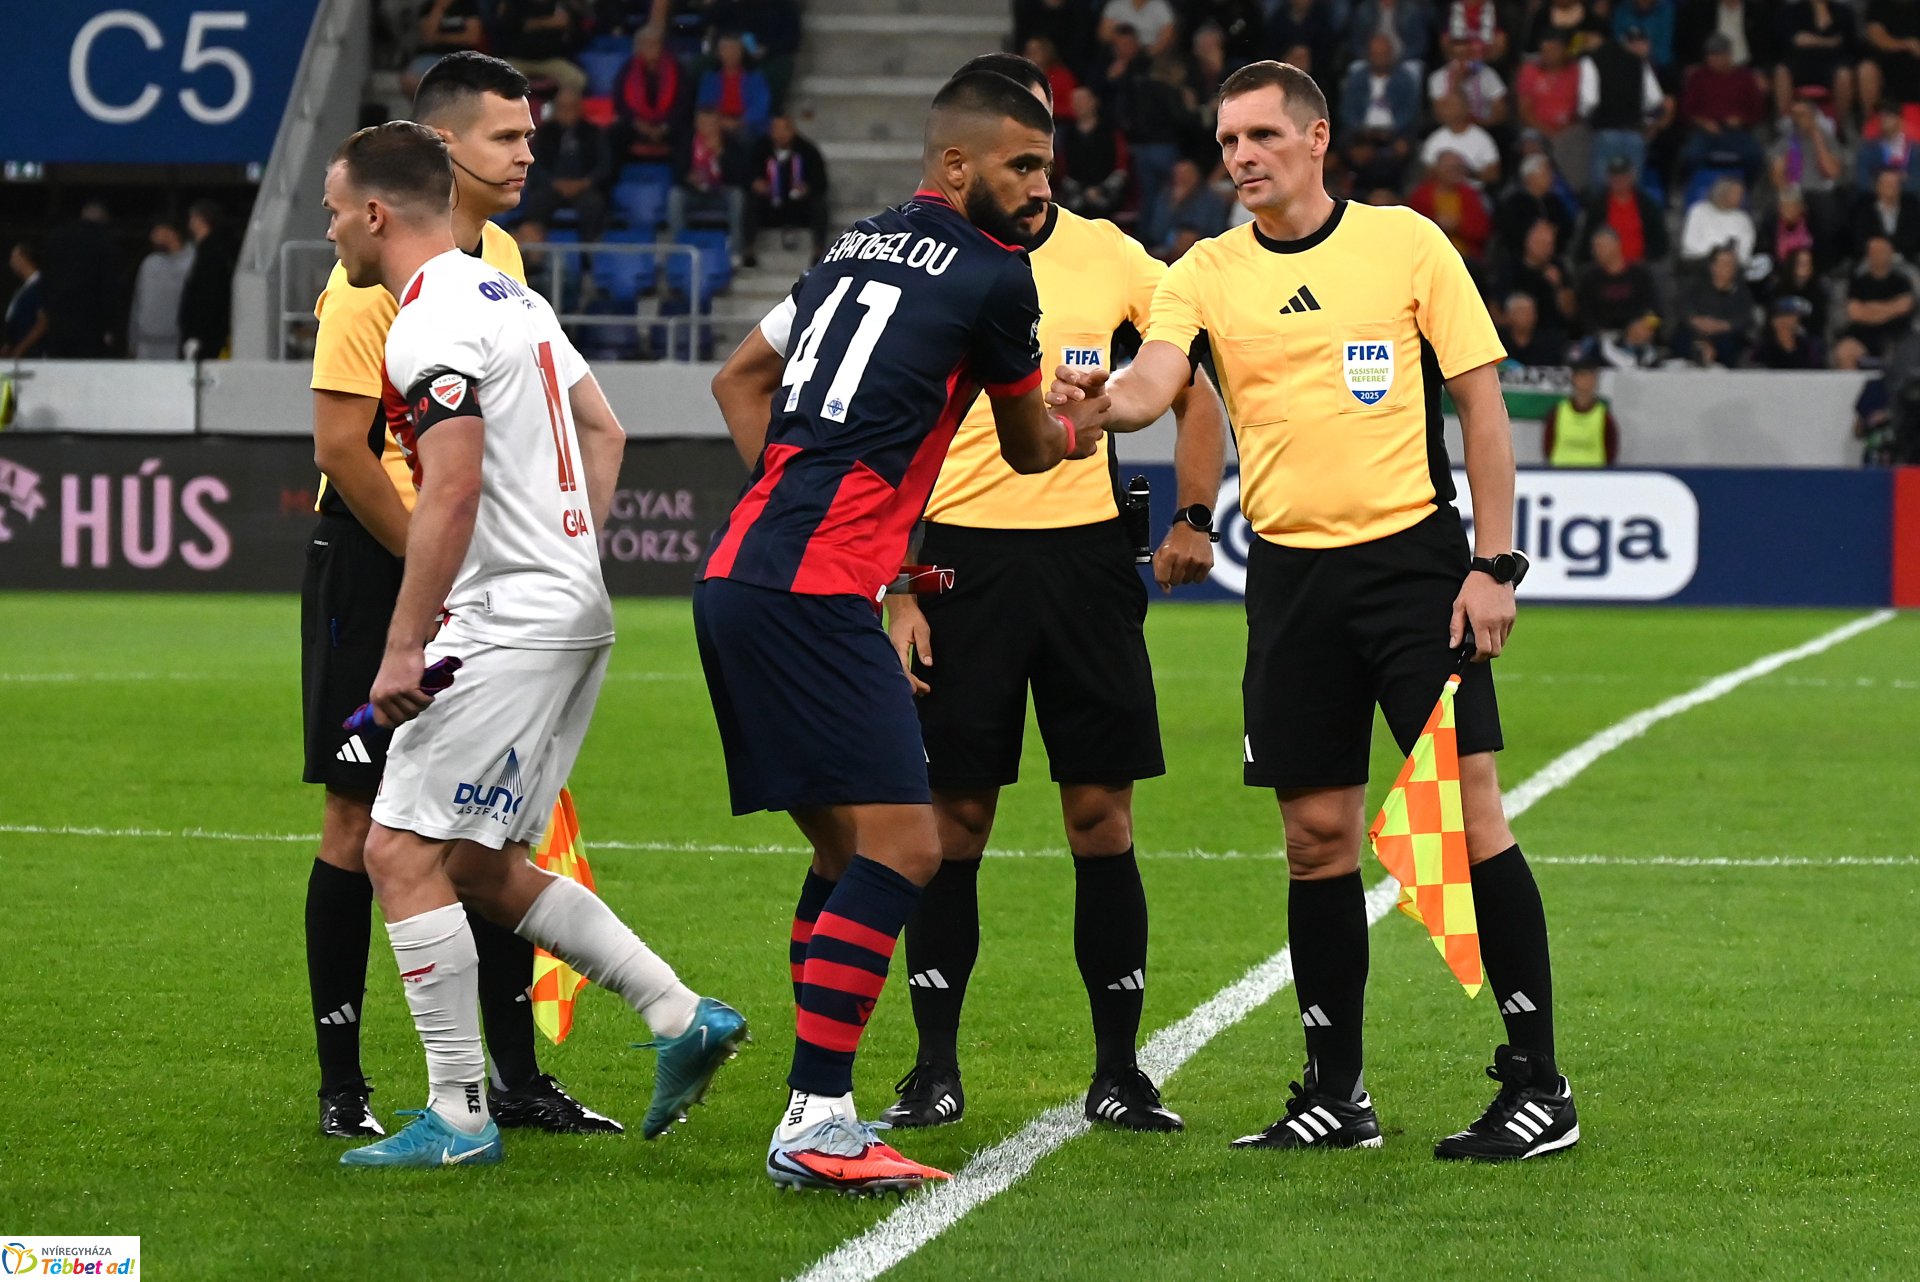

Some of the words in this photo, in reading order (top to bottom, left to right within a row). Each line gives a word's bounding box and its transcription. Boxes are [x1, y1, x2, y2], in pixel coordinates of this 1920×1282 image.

[68, 10, 254, 124] C5
[782, 276, 902, 424] 41
[1065, 350, 1100, 366] FIFA
[1347, 345, 1389, 361] FIFA
[1348, 367, 1390, 375] ASSISTANT
[1351, 375, 1387, 383] REFEREE
[1360, 391, 1380, 400] 2025
[60, 457, 232, 571] HÚS
[610, 489, 696, 520] GYAR
[456, 805, 509, 825] ASZFAL
[787, 1091, 810, 1127] CTOR
